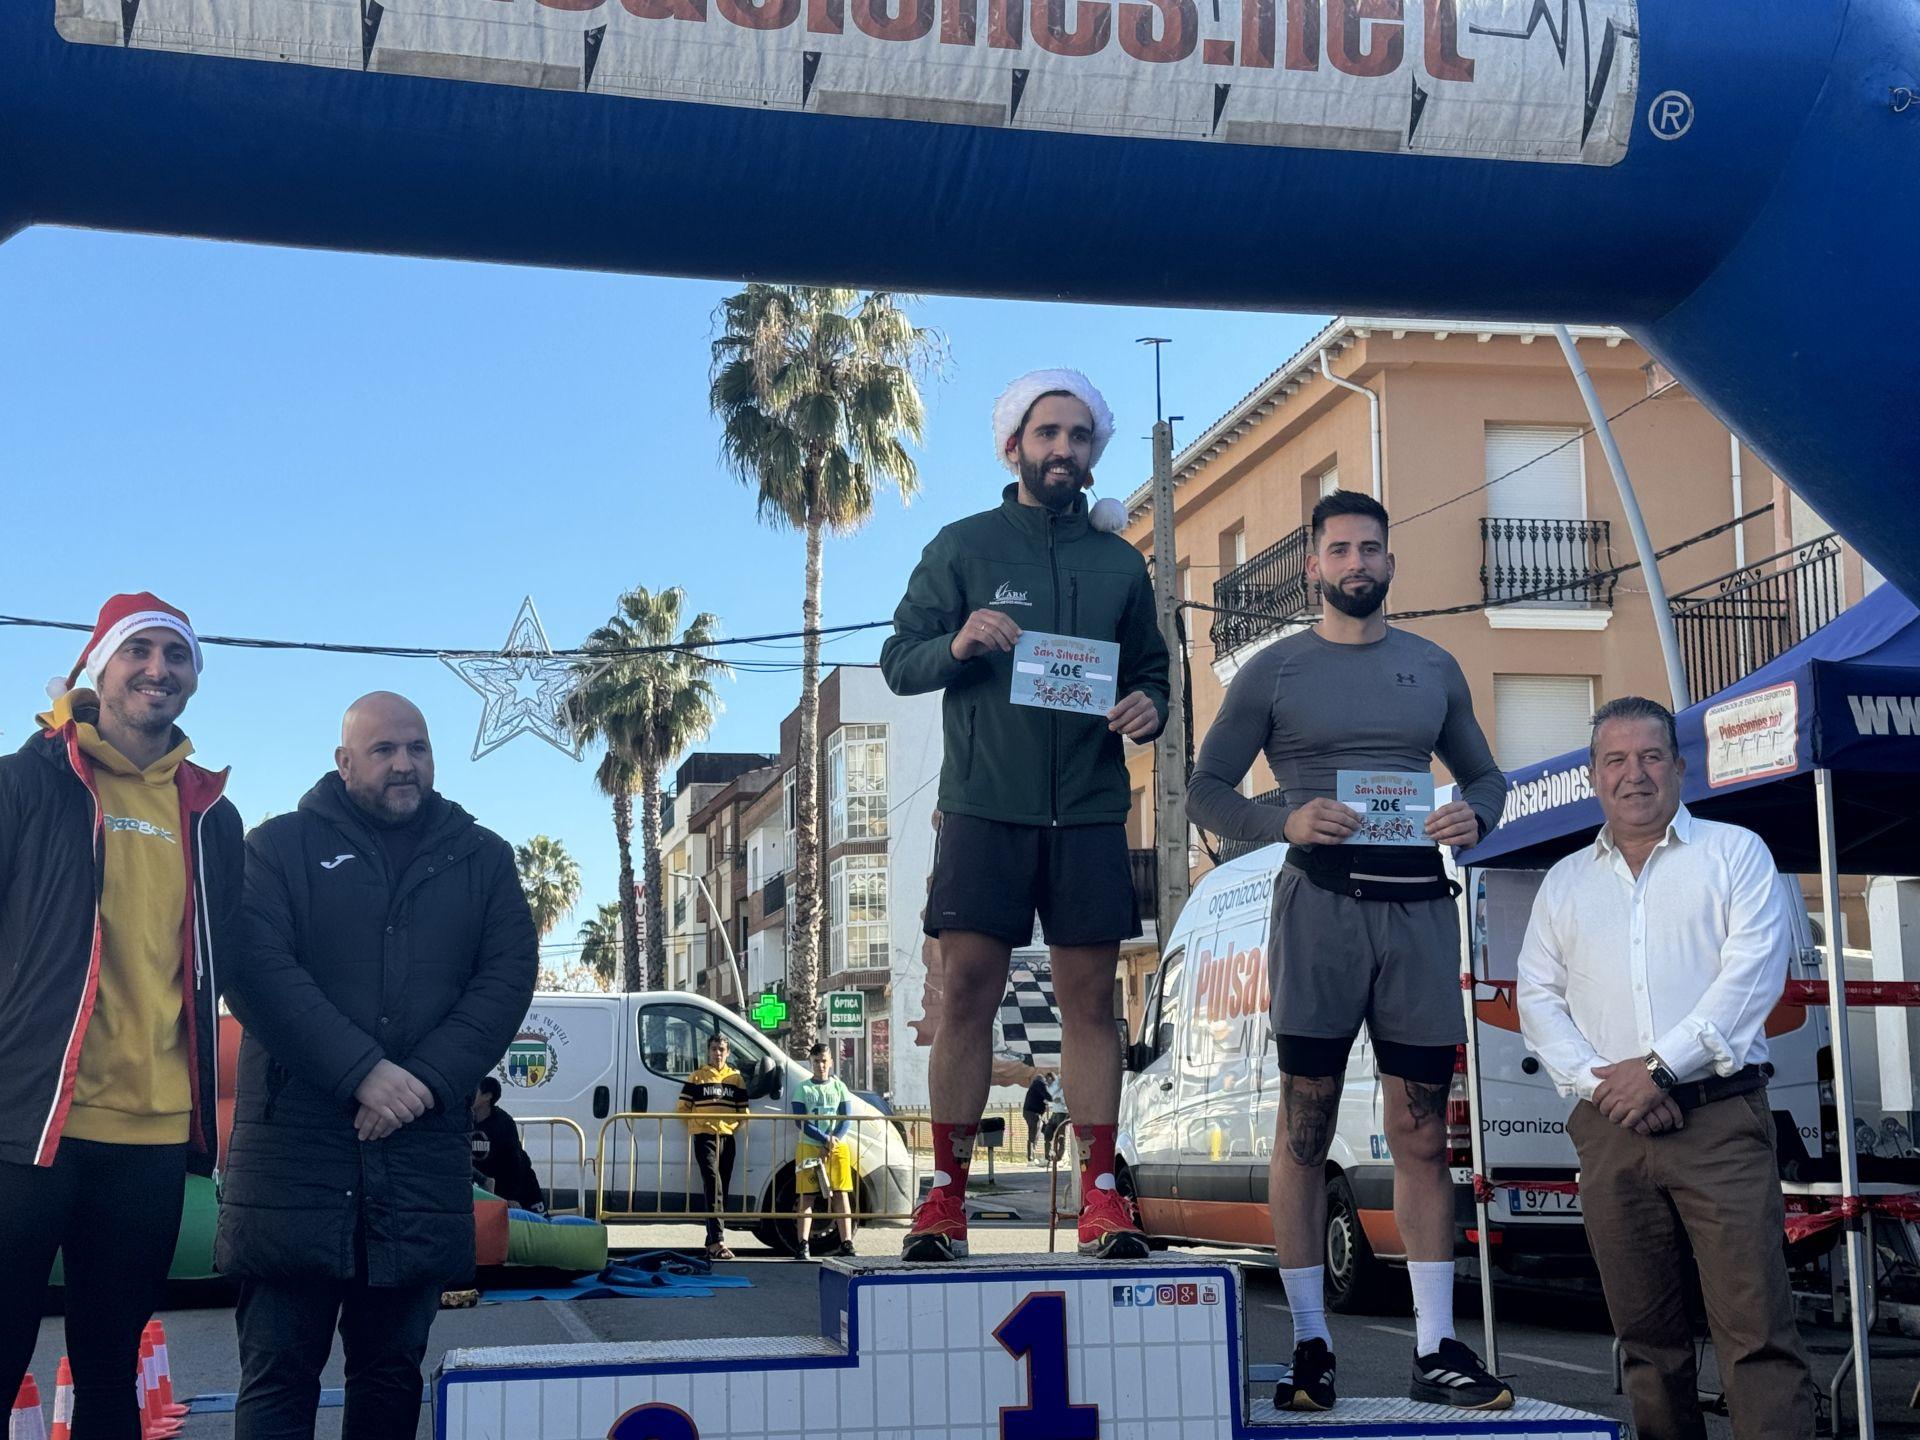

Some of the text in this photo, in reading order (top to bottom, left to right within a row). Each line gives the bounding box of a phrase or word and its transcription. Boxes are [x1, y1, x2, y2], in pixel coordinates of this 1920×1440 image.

[1049, 662, 1082, 678] 40€
[1354, 784, 1418, 796] San Silvestre
[1371, 799, 1400, 812] 20€
[1208, 870, 1272, 919] organizació
[834, 996, 859, 1009] ÓPTICA
[832, 1013, 862, 1023] ESTEBAN
[703, 1086, 722, 1097] Nike
[1482, 1117, 1567, 1136] organiza
[991, 1291, 1100, 1440] 1
